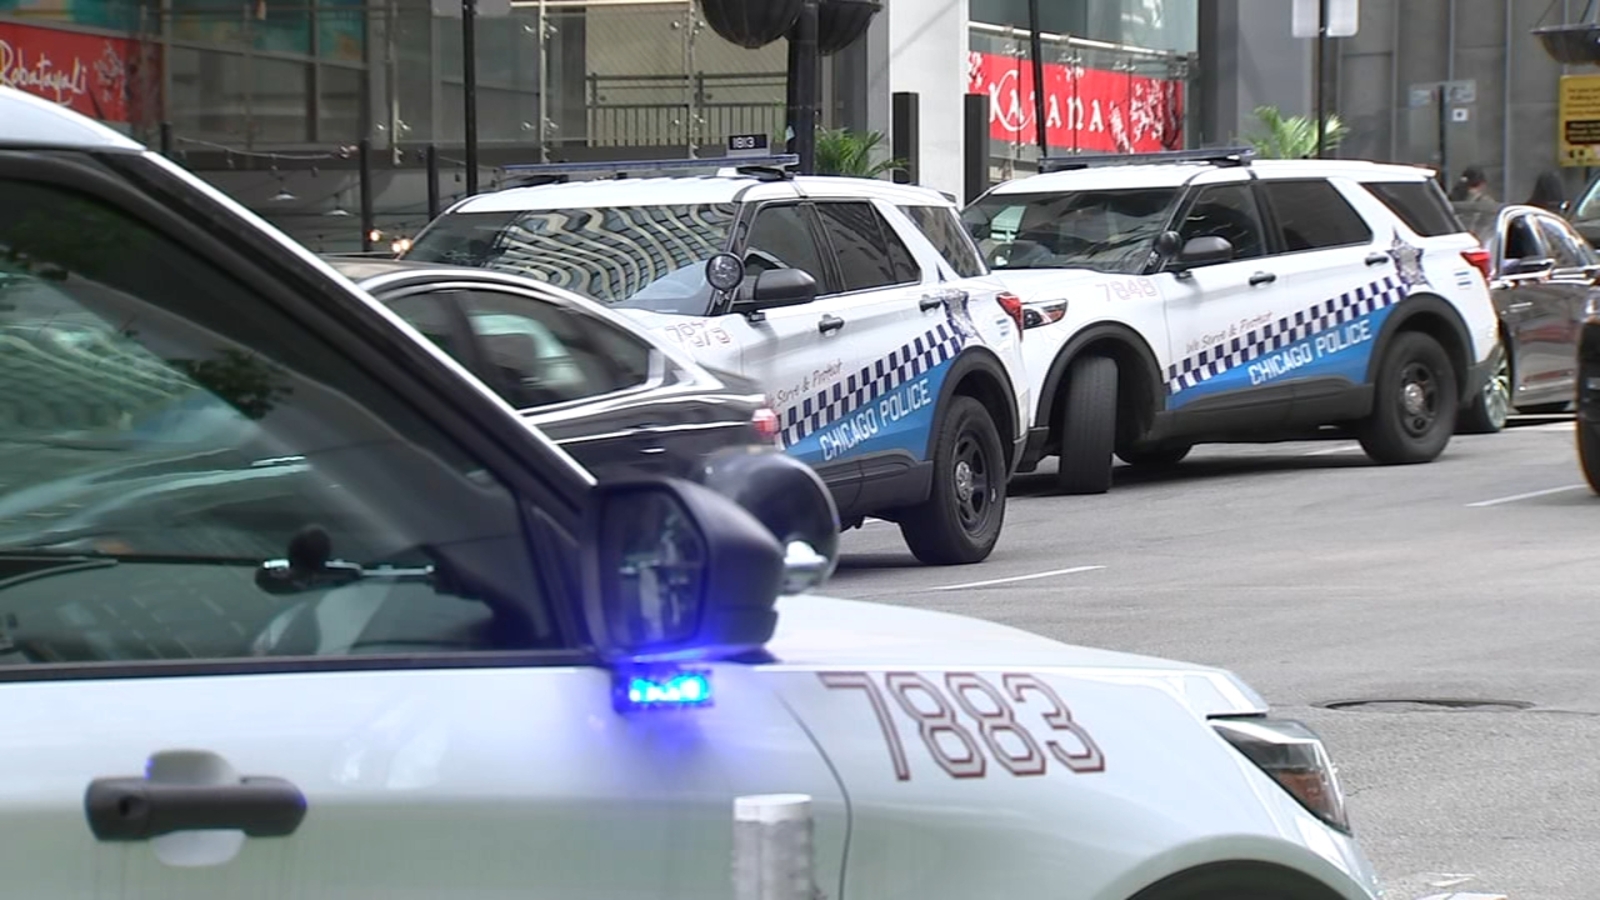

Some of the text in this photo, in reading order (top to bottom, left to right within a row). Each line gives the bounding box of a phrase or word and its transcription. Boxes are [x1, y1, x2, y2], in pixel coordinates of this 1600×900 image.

[1095, 277, 1158, 302] 7848
[1247, 320, 1372, 385] CHICAGO POLICE
[819, 378, 932, 461] CHICAGO POLICE
[816, 671, 1106, 781] 7883
